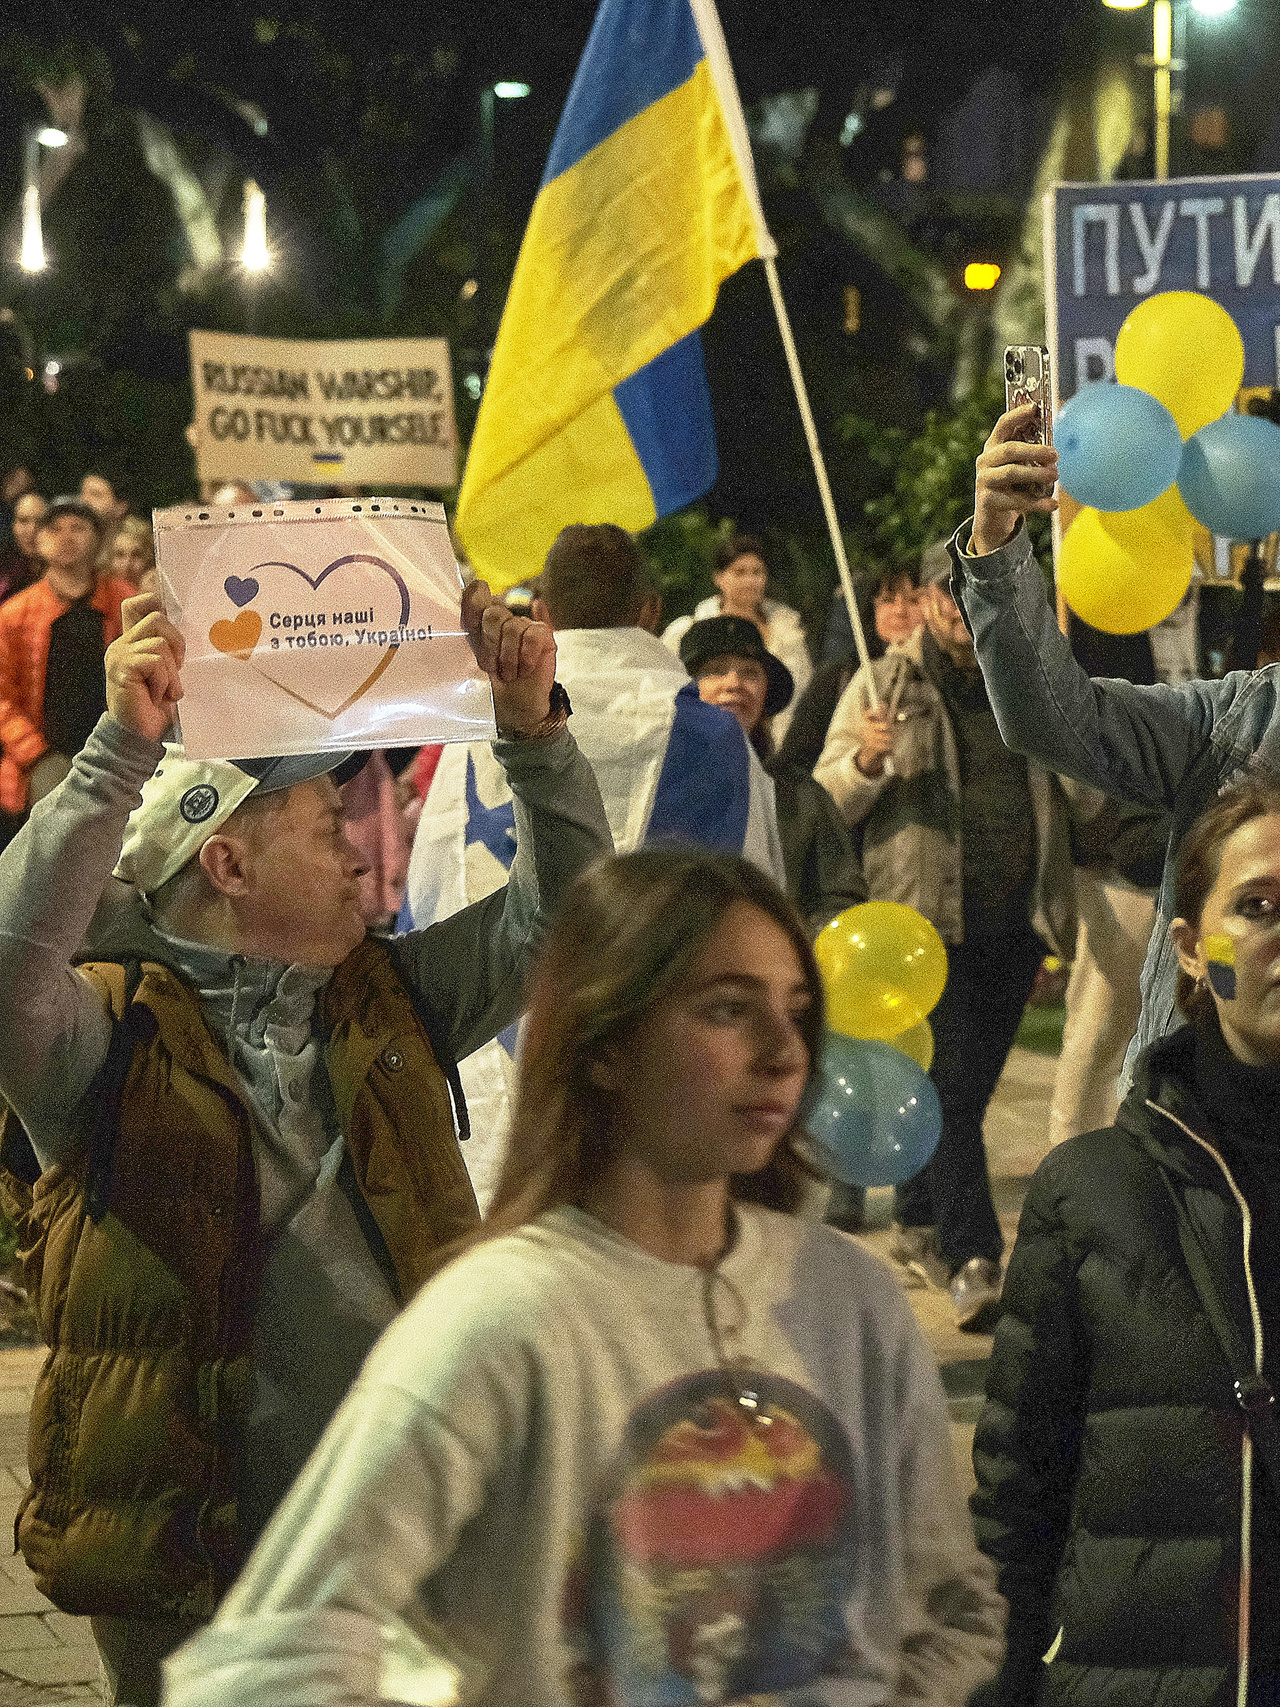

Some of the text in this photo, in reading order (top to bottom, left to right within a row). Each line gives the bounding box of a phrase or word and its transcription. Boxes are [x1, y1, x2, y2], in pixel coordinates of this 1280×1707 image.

[203, 361, 309, 399] RUSSIAN
[210, 407, 250, 441] GO
[255, 410, 316, 445] FUCK
[269, 608, 374, 630] Серця наші
[270, 625, 432, 649] з тобою, Україно!
